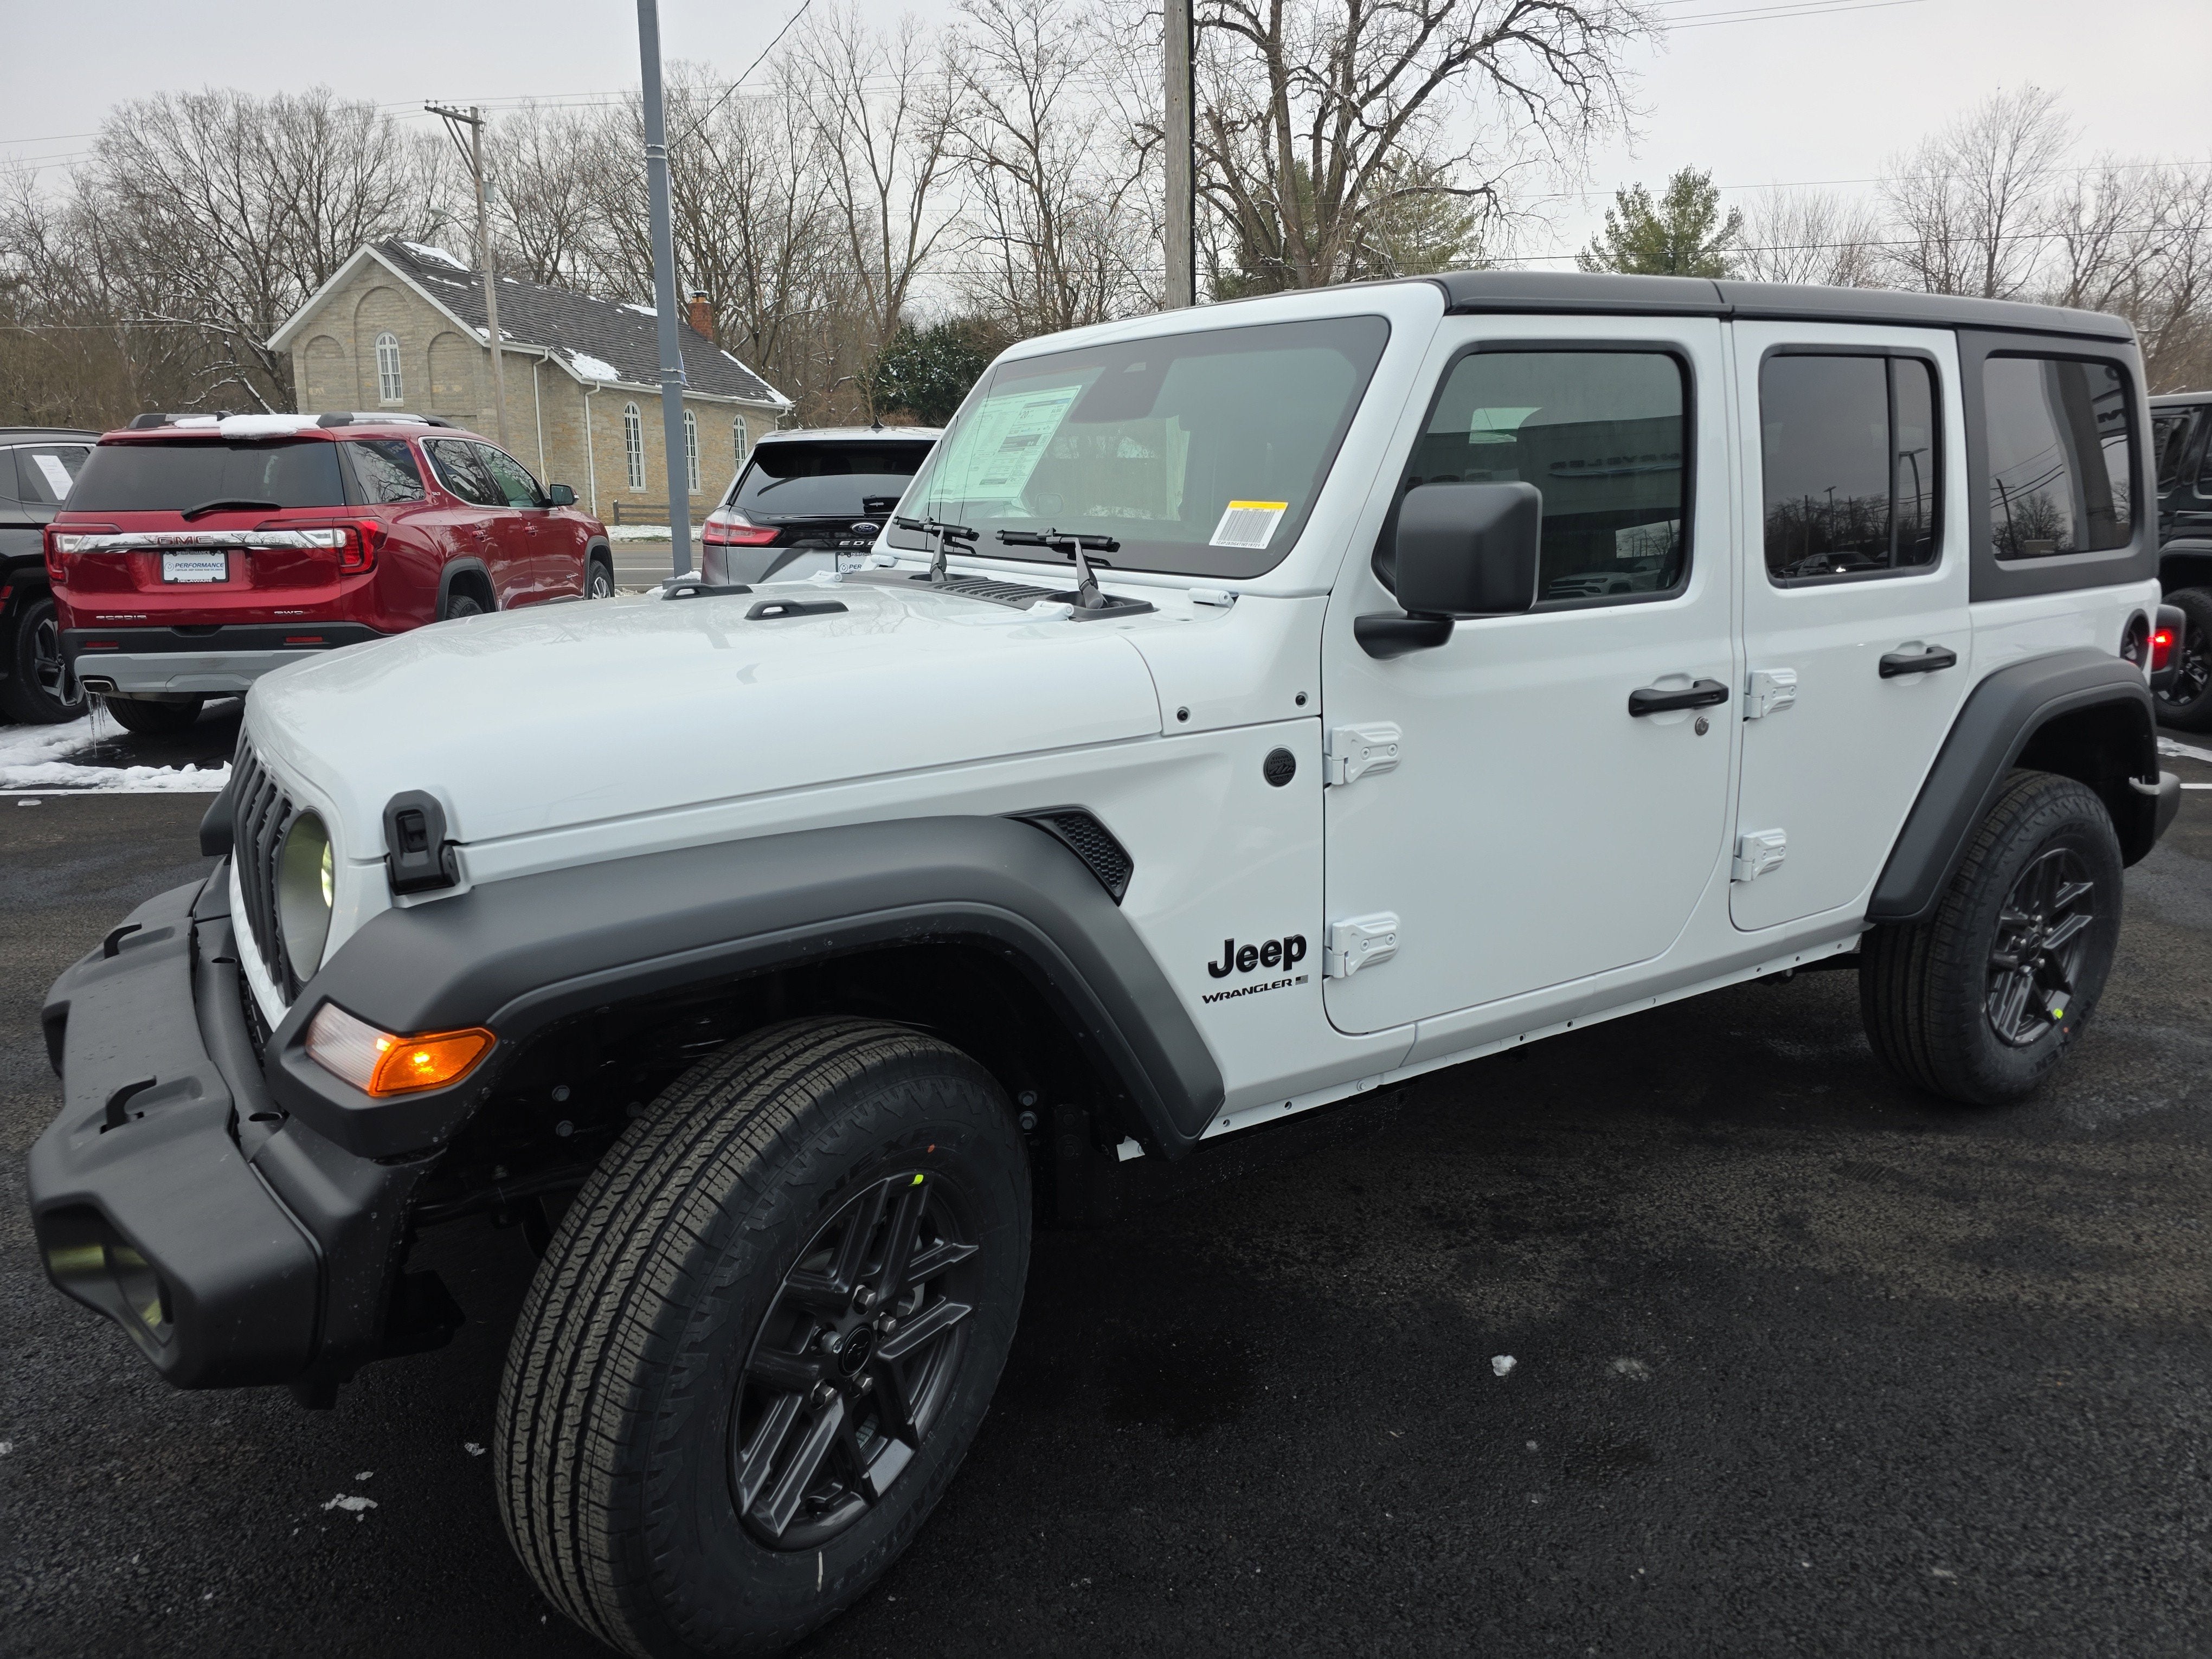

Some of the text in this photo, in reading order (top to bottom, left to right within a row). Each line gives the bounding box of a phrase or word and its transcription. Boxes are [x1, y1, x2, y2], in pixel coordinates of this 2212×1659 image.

[157, 536, 214, 545] GMC
[1208, 934, 1307, 979] Jeep
[1201, 978, 1293, 1004] WRANGLER
